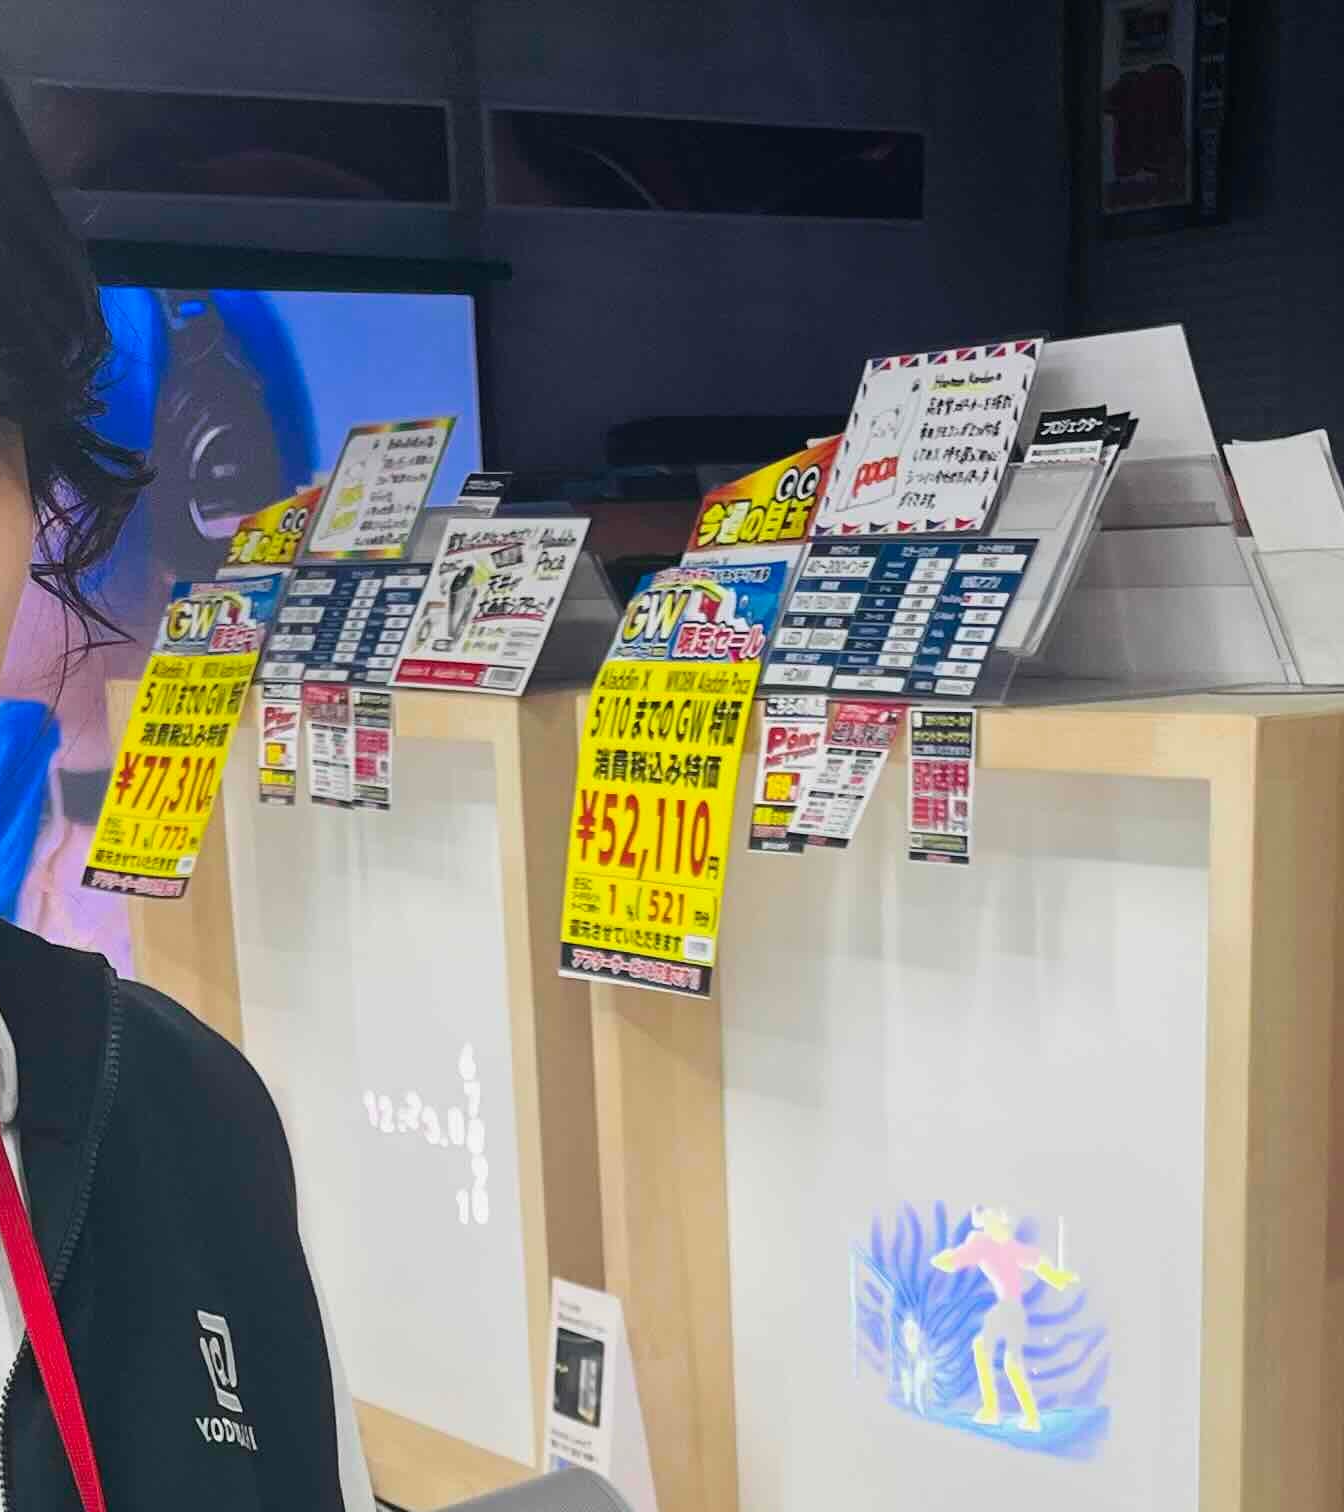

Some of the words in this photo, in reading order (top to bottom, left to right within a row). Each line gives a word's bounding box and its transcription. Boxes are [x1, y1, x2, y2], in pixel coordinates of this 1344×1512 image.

[697, 499, 815, 547] 今週の目玉
[165, 599, 219, 644] GW
[621, 589, 691, 642] GW
[593, 749, 722, 789] 消費税込み特価
